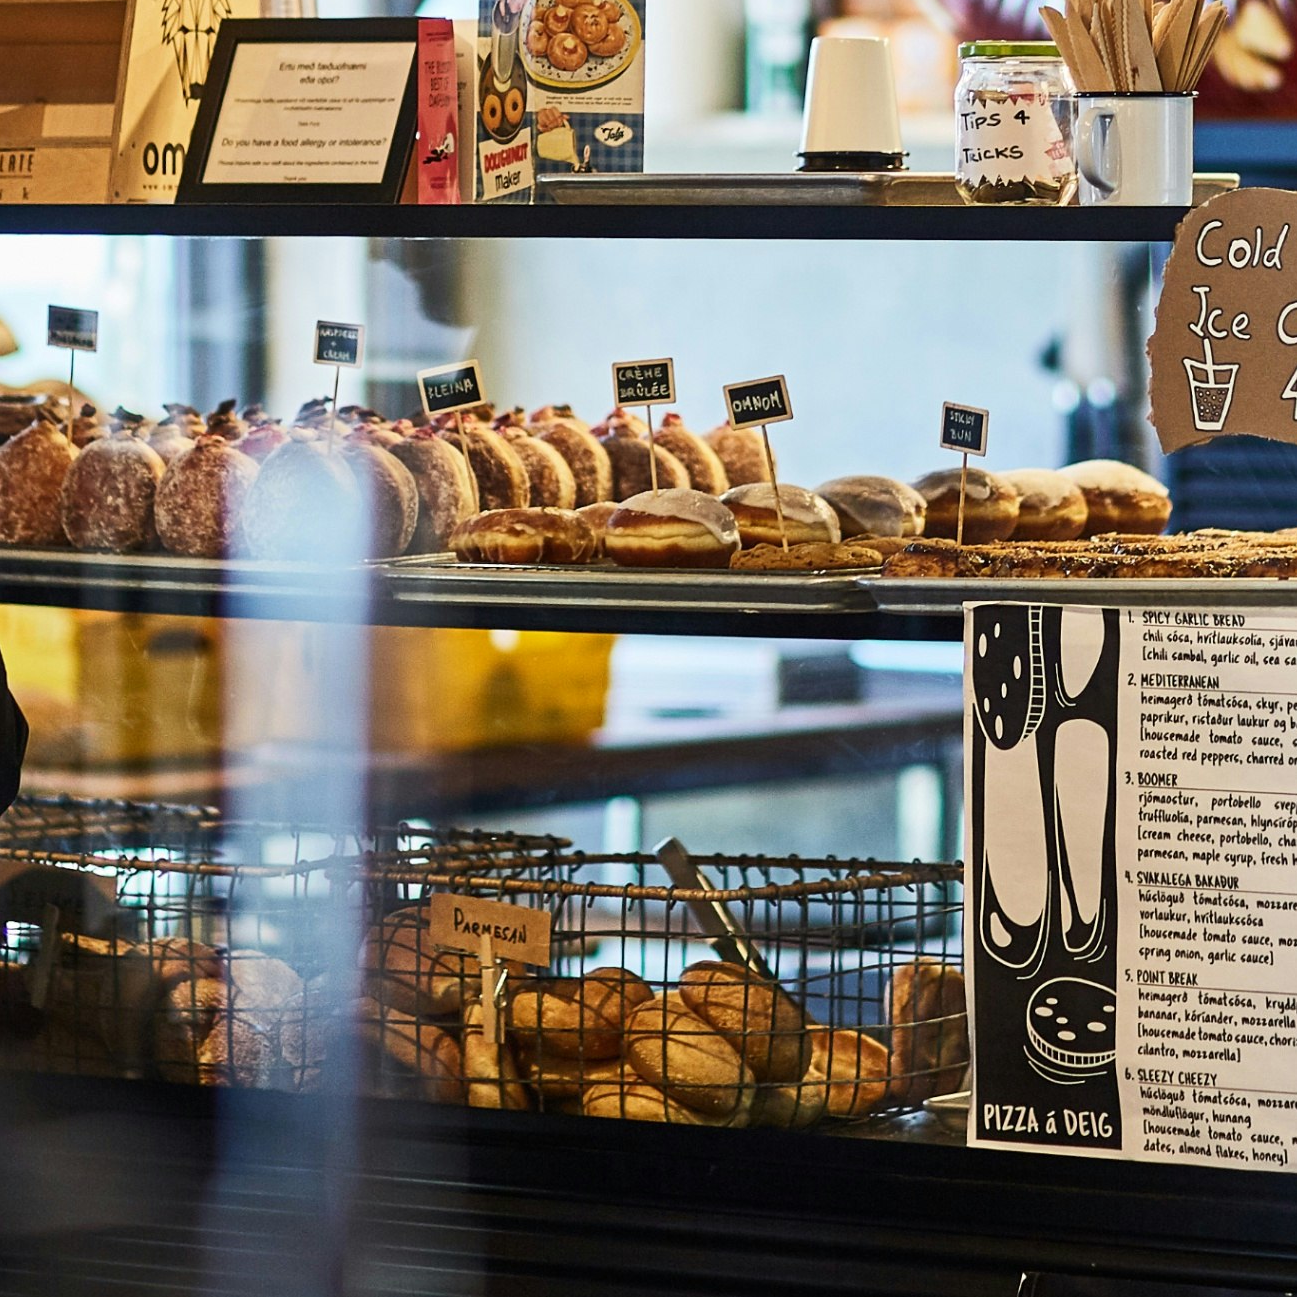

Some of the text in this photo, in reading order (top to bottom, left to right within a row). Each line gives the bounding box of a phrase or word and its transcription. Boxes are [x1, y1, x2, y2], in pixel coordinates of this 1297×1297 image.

[1014, 110, 1030, 125] 4
[221, 137, 234, 146] Do
[235, 139, 251, 149] you
[253, 137, 271, 147] have
[281, 137, 298, 147] food
[300, 137, 326, 149] allergy
[339, 137, 387, 147] intolerance?
[1196, 220, 1290, 269] Cold
[1189, 286, 1252, 339] Ice
[1142, 610, 1170, 624] SPICY
[1175, 612, 1209, 626] GARLIC
[1212, 614, 1245, 627] BREAD
[1128, 673, 1219, 689] 2. MEDITERRANEAN
[1125, 771, 1177, 787] 3. BOOMER
[1137, 871, 1191, 888] SVAKALEGA
[1139, 947, 1273, 965] spring onion, garlic sauce]
[1125, 1068, 1217, 1086] 6. SLEEZY CHEEZY
[984, 1104, 1112, 1137] PIZZA á DEIG
